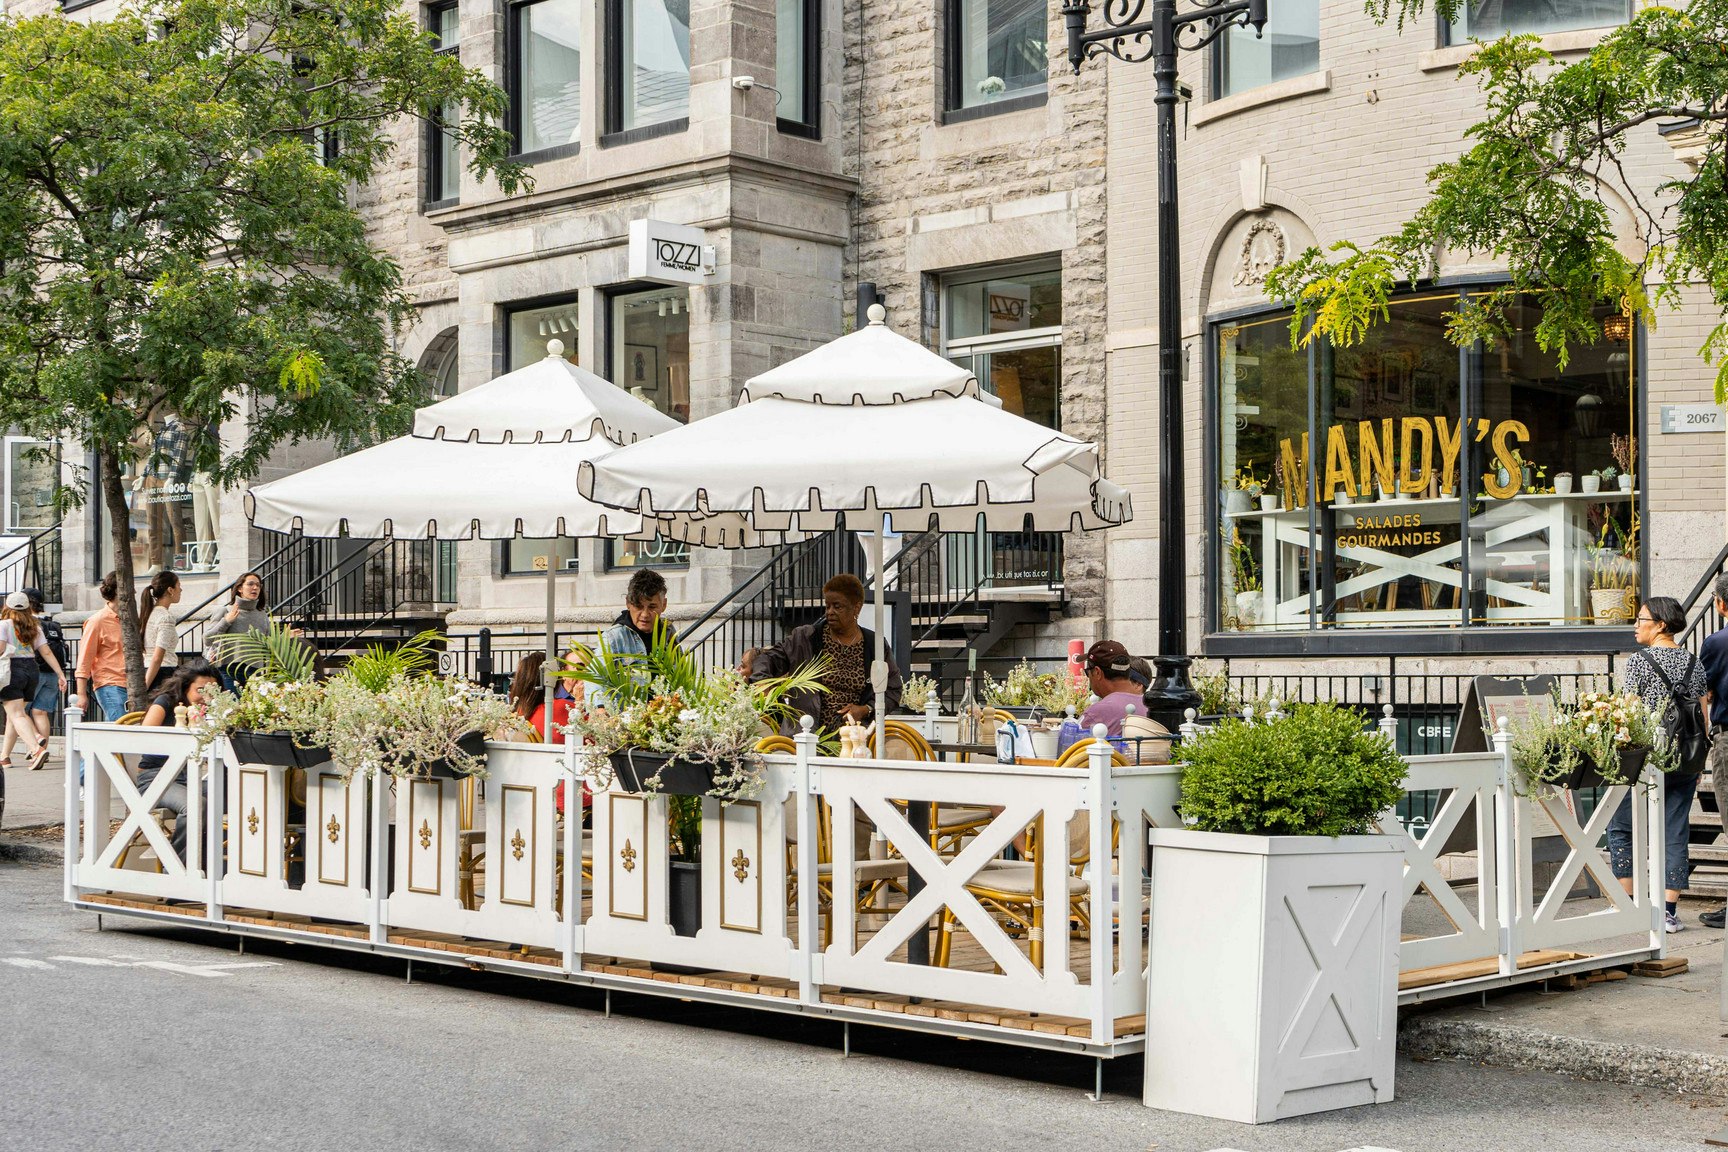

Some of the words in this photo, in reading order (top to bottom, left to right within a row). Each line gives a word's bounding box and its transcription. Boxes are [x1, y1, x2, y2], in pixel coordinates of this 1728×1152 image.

[652, 238, 701, 266] TOZZI
[1686, 413, 1717, 424] 2067
[1279, 416, 1531, 513] MANDY'S
[1356, 514, 1421, 530] SALADES
[1337, 531, 1442, 549] GOURMANDES
[1417, 725, 1452, 738] CBRE
